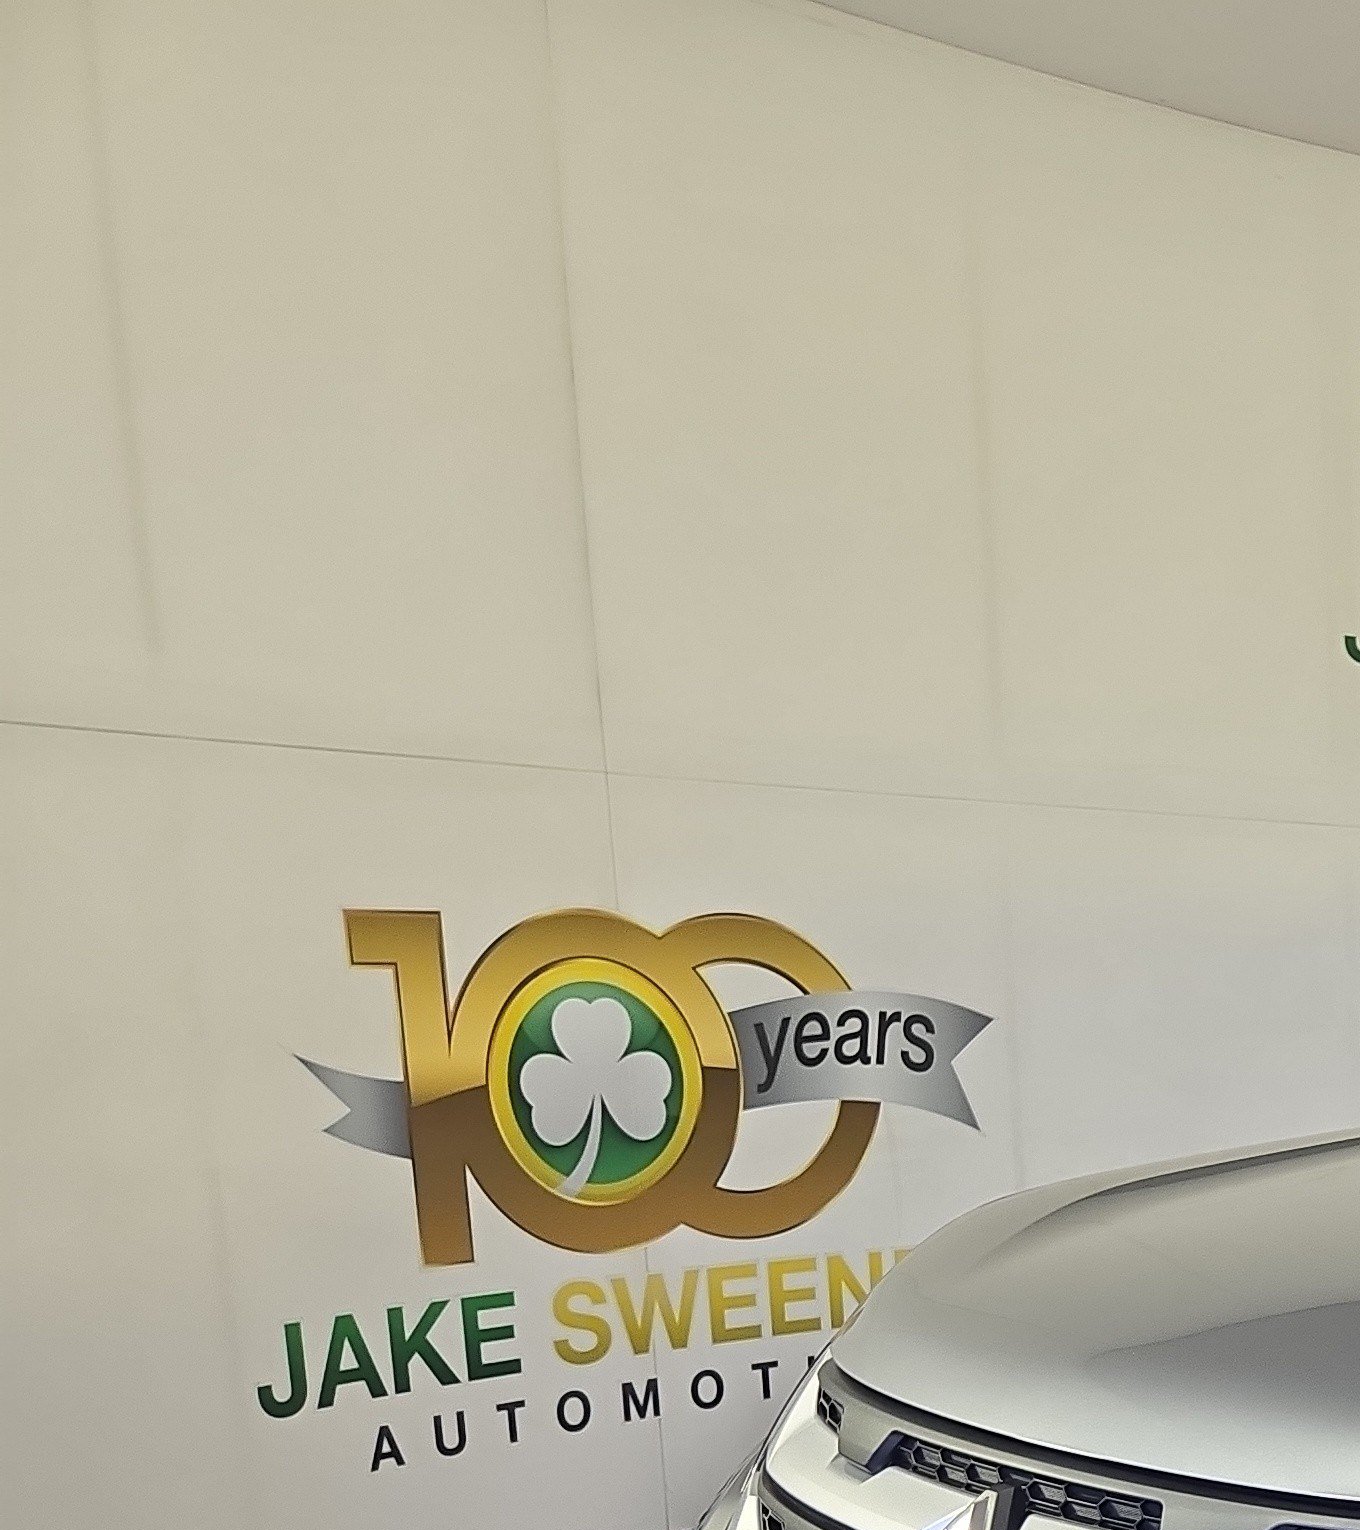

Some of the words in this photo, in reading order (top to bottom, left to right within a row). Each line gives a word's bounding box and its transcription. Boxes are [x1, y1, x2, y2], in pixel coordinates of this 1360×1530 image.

[344, 908, 881, 1267] 100
[756, 1008, 935, 1093] years
[257, 1290, 522, 1419] JAKE
[552, 1249, 915, 1365] SWEEN
[370, 1356, 815, 1471] AUTOMOT
